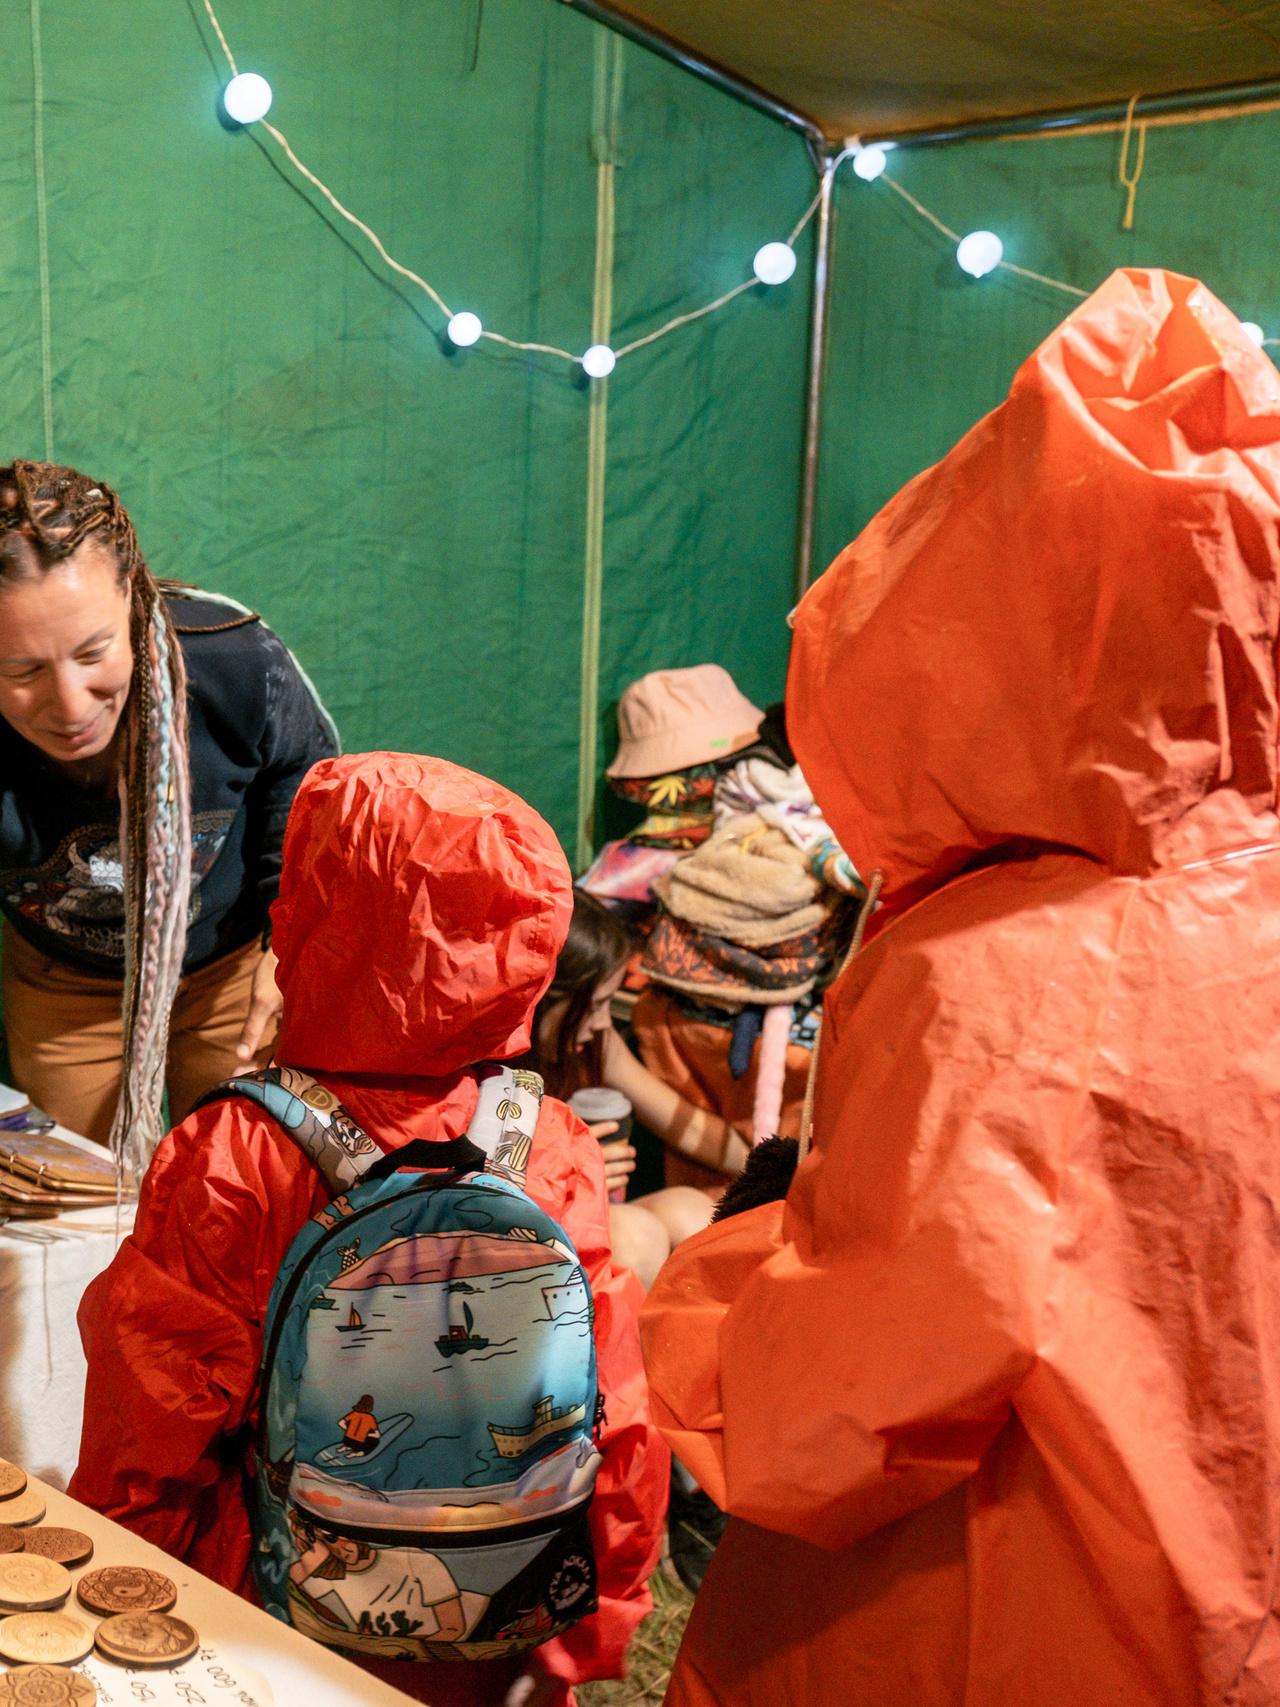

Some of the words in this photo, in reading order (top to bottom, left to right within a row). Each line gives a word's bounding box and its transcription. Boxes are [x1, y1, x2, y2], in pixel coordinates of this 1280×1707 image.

[206, 1666, 236, 1688] 600
[130, 1681, 157, 1703] 150
[175, 1682, 207, 1705] 250
